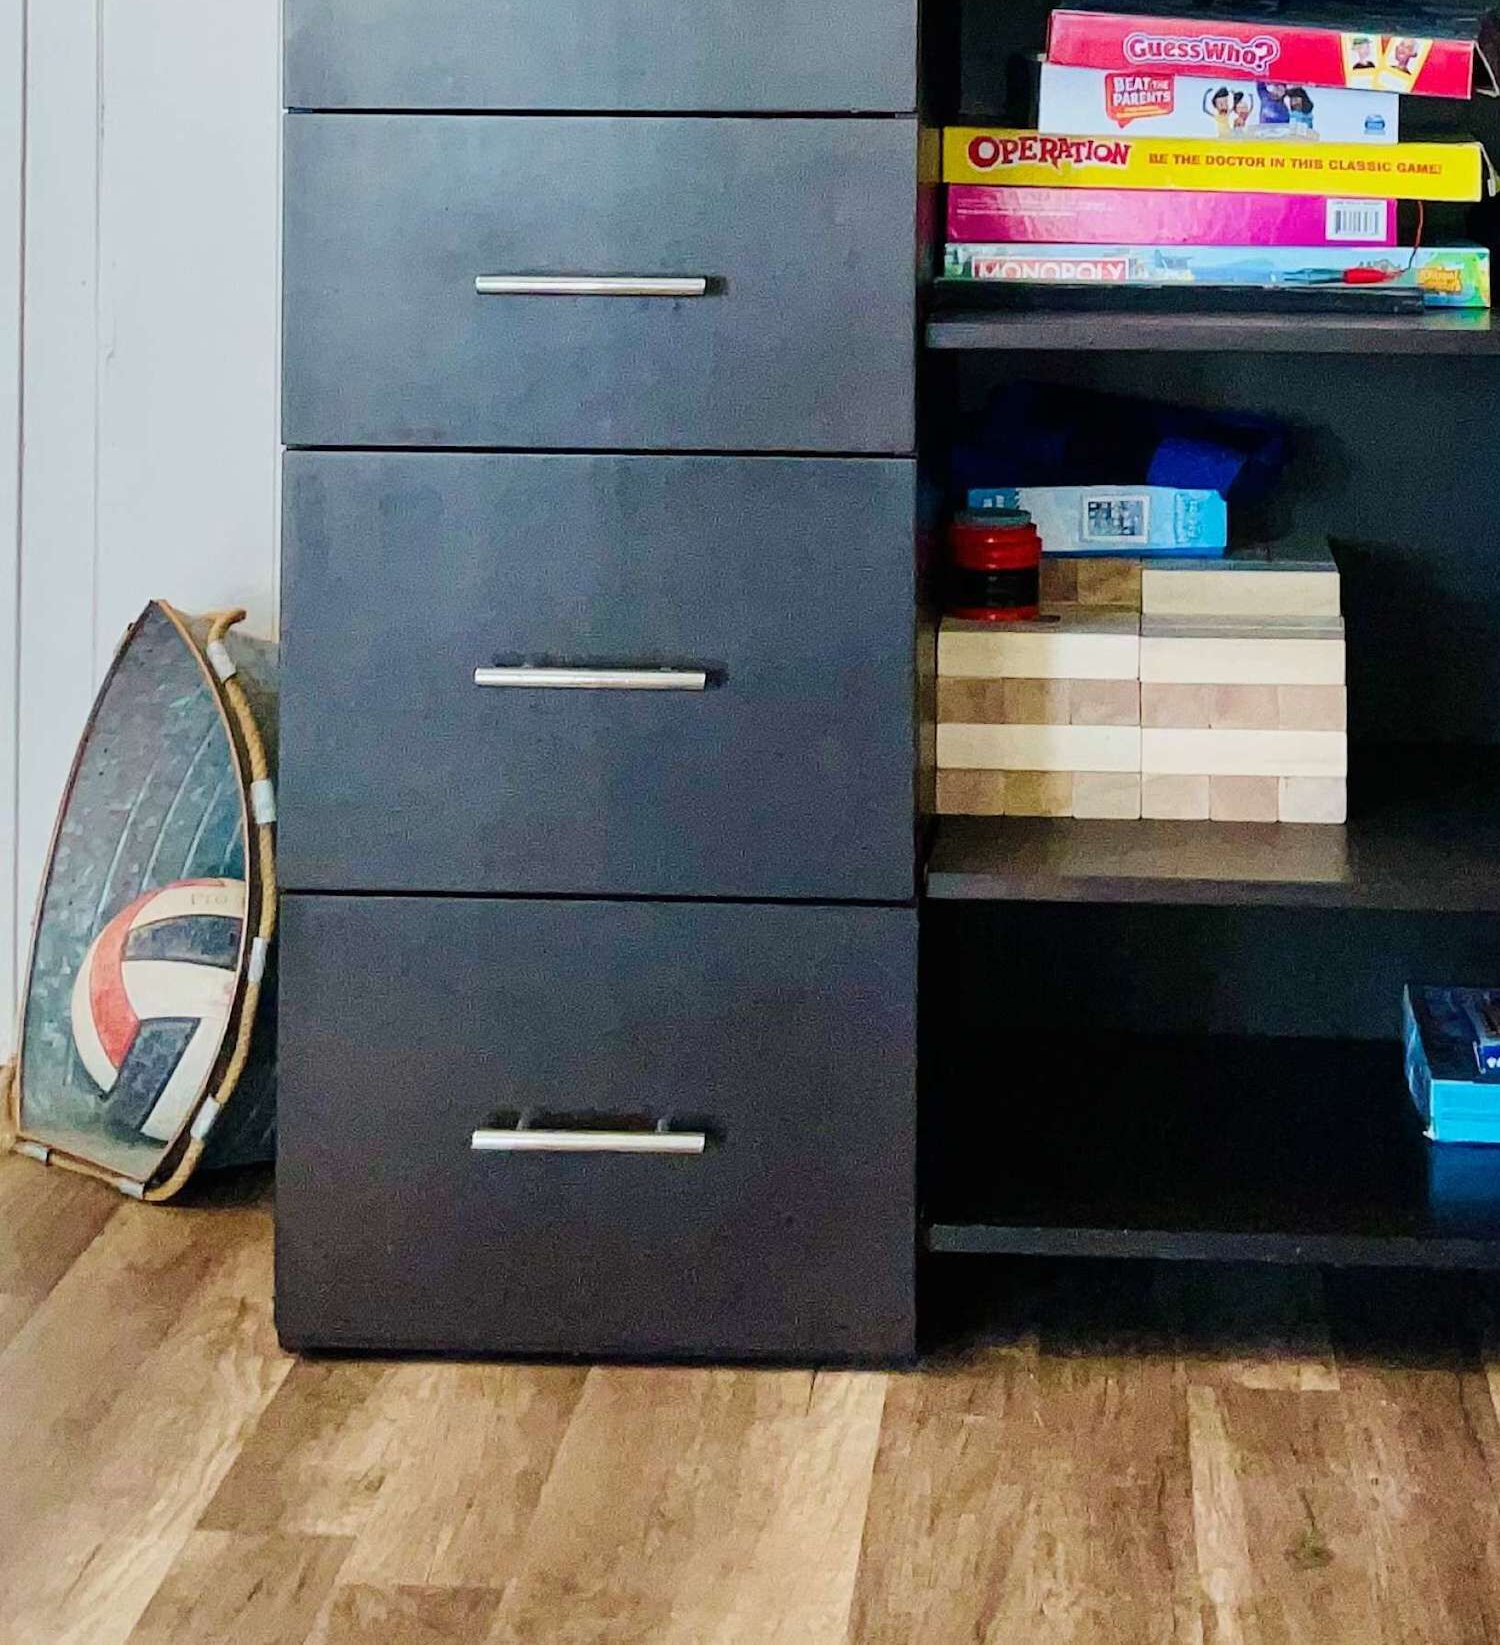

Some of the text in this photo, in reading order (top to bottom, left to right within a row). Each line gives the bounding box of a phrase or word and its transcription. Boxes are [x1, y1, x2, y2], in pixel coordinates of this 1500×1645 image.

[1112, 77, 1151, 93] BEAT
[1112, 91, 1172, 107] PARENTS
[968, 135, 1132, 169] OPERATION
[1149, 154, 1443, 175] BE THE DOCTOR IN THIS CLASSIC GAME!
[979, 259, 1125, 280] MONOPOLY
